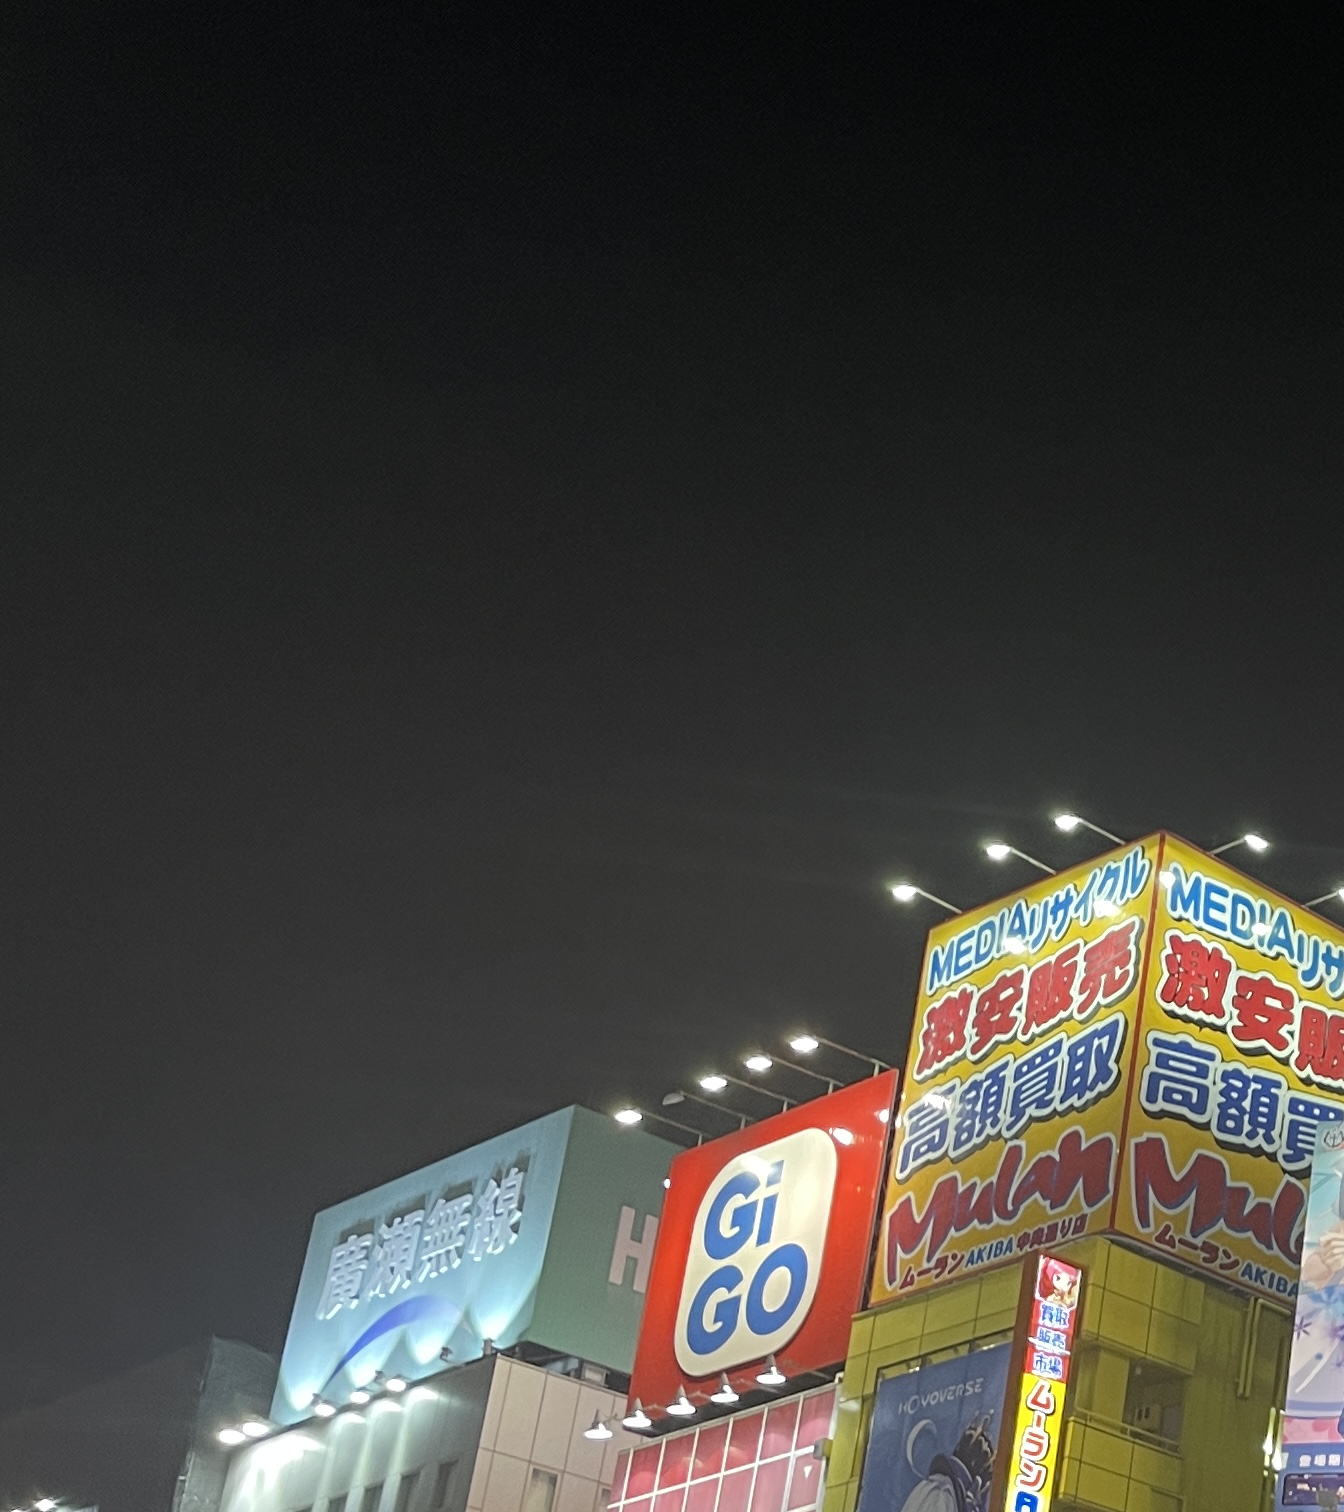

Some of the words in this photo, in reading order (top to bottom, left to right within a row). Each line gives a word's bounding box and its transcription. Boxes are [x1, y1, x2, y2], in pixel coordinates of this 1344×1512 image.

[915, 920, 1143, 1081] 激安販売
[897, 1013, 1127, 1180] 高額買取
[1145, 1030, 1344, 1173] 高額買
[888, 1129, 1116, 1288] Mulan
[965, 1237, 1014, 1268] AKIBA
[1131, 1134, 1305, 1270] Mul
[1025, 1381, 1055, 1491] ムーラン
